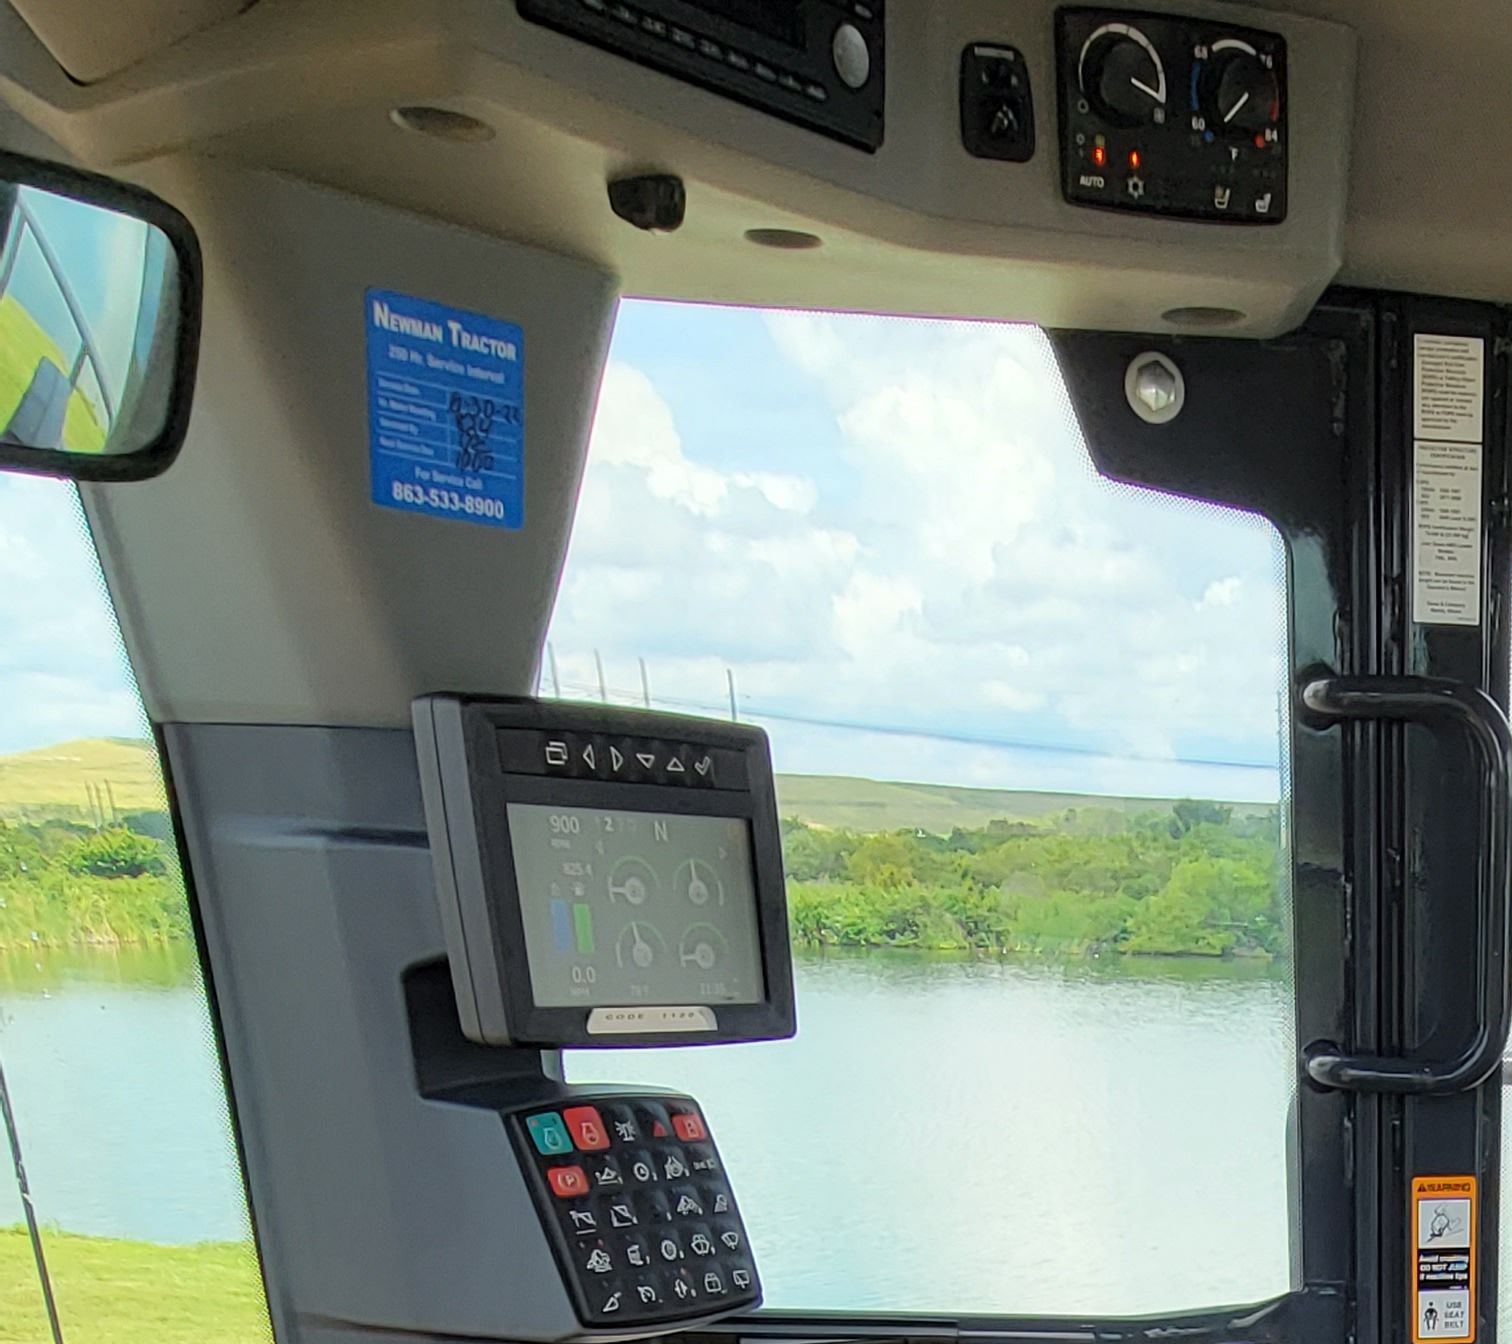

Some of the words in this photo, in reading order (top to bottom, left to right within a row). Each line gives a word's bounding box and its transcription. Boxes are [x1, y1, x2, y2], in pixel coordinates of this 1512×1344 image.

[1080, 175, 1104, 188] AUTO
[392, 480, 504, 519] 863-533-8900
[550, 815, 580, 833] 900
[654, 820, 669, 842] N
[572, 966, 596, 984] 0.0
[1446, 1301, 1462, 1309] USE
[1444, 1320, 1464, 1328] BELT
